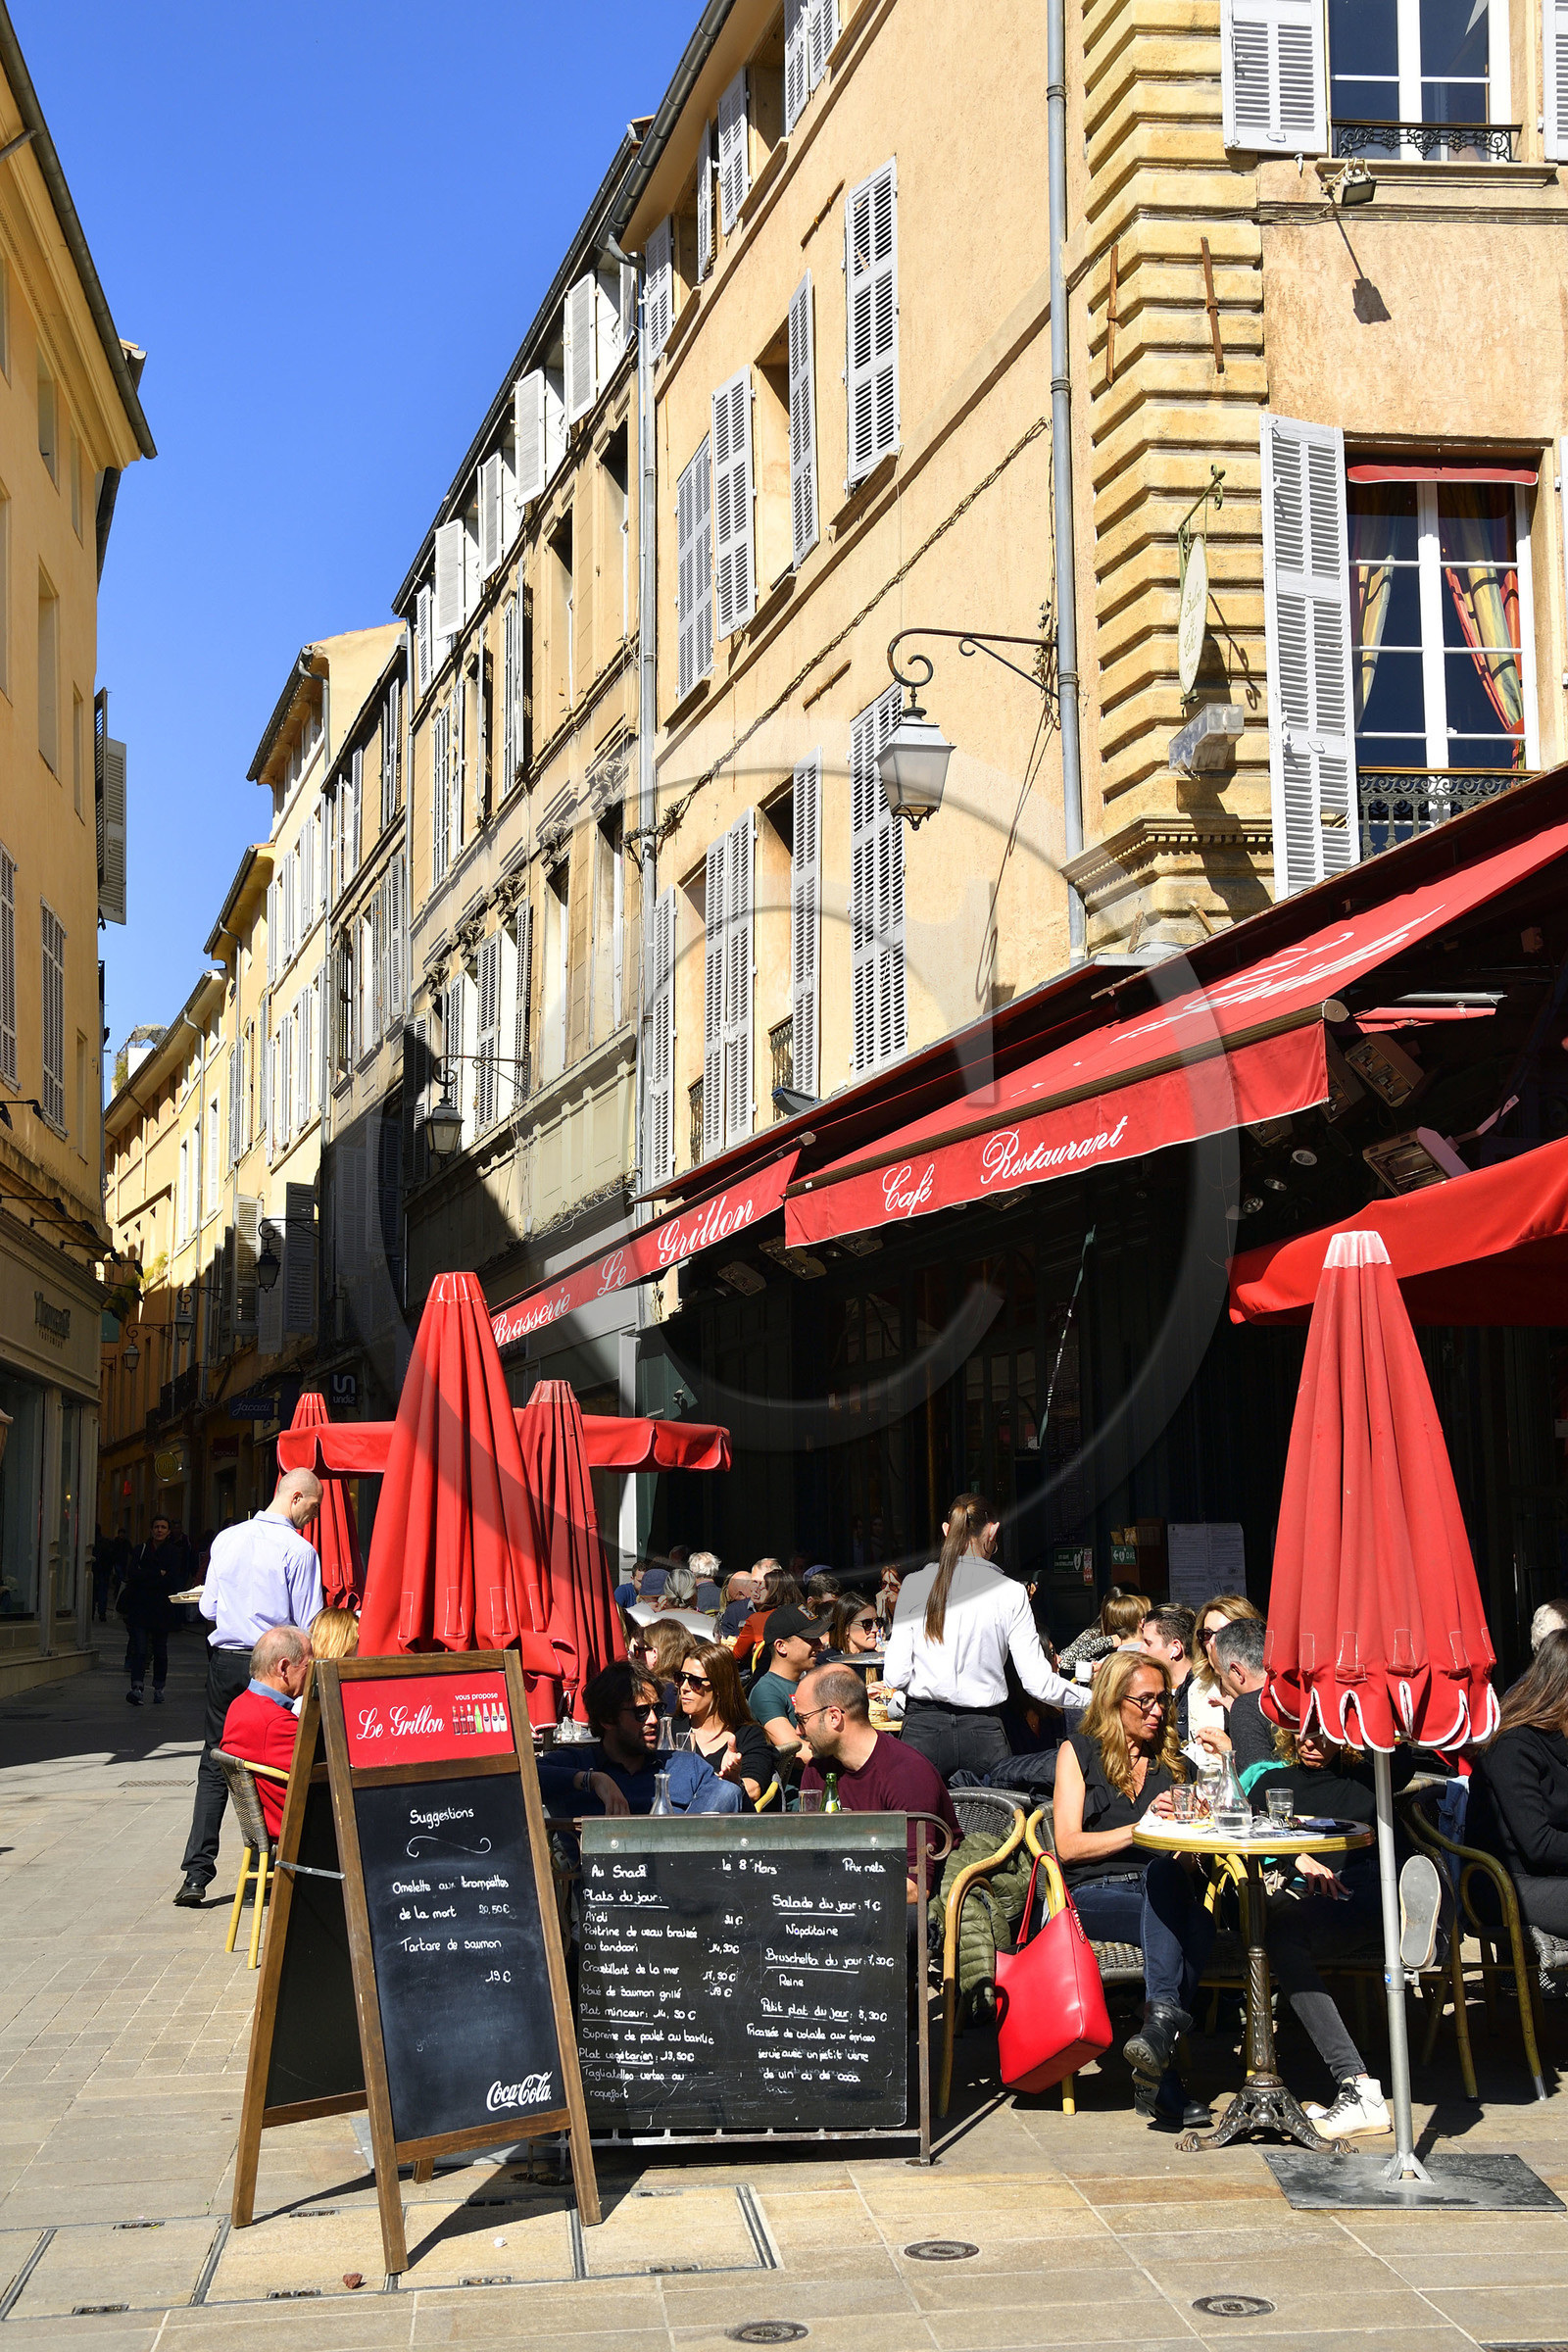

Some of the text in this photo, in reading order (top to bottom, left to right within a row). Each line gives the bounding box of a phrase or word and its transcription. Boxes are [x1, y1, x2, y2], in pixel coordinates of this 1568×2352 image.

[882, 1115, 1129, 1217] Café Restaurant
[491, 1195, 755, 1346] Brasserie Le Grillon
[471, 1692, 499, 1701] propose
[356, 1704, 446, 1740] Le Grillon
[410, 1806, 474, 1830] Suggestions
[591, 1864, 647, 1878] Au Snack
[739, 1859, 747, 1870] 8
[754, 1861, 778, 1875] Mars
[842, 1857, 886, 1873] Prix nets
[392, 1874, 510, 1894] Omelette aux trompettes
[583, 1887, 614, 1901] Plats
[619, 1889, 633, 1901] du
[772, 1893, 813, 1909] Salade
[818, 1897, 833, 1909] du
[399, 1907, 412, 1921] de
[432, 1905, 458, 1919] mort
[583, 1922, 698, 1938] Poitrine de veau braisée
[785, 1923, 839, 1938] Napolitaine
[400, 1936, 502, 1953] Tartare de saumon
[584, 1942, 597, 1951] au
[600, 1940, 638, 1952] tandoori
[764, 1947, 819, 1966] Bruschetta
[825, 1953, 838, 1966] du
[582, 1960, 629, 1975] Croustillant
[635, 1963, 647, 1975] de
[778, 1974, 805, 1987] Reine
[581, 1984, 602, 1996] Pavé
[606, 1984, 616, 1996] de
[620, 1987, 655, 1997] saumon
[660, 1986, 682, 2002] grillé
[579, 2003, 601, 2016] Plat
[760, 1997, 784, 2013] Petit
[788, 2003, 808, 2018] plat
[813, 2005, 827, 2017] du
[624, 2029, 637, 2040] de
[640, 2029, 664, 2043] poulet
[683, 2029, 714, 2045] basilic
[746, 2023, 779, 2037] Fricassée
[783, 2029, 794, 2039] de
[830, 2032, 847, 2040] aux
[578, 2047, 601, 2059] Plat
[758, 2046, 869, 2063] servie avec un petit verre
[582, 2063, 685, 2082] Tagliatelles vertes au
[763, 2068, 775, 2080] de
[778, 2070, 795, 2080] vin
[801, 2072, 812, 2082] ou
[819, 2069, 831, 2081] de
[486, 2071, 553, 2112] Coca-Cola
[589, 2087, 629, 2102] roquefort
